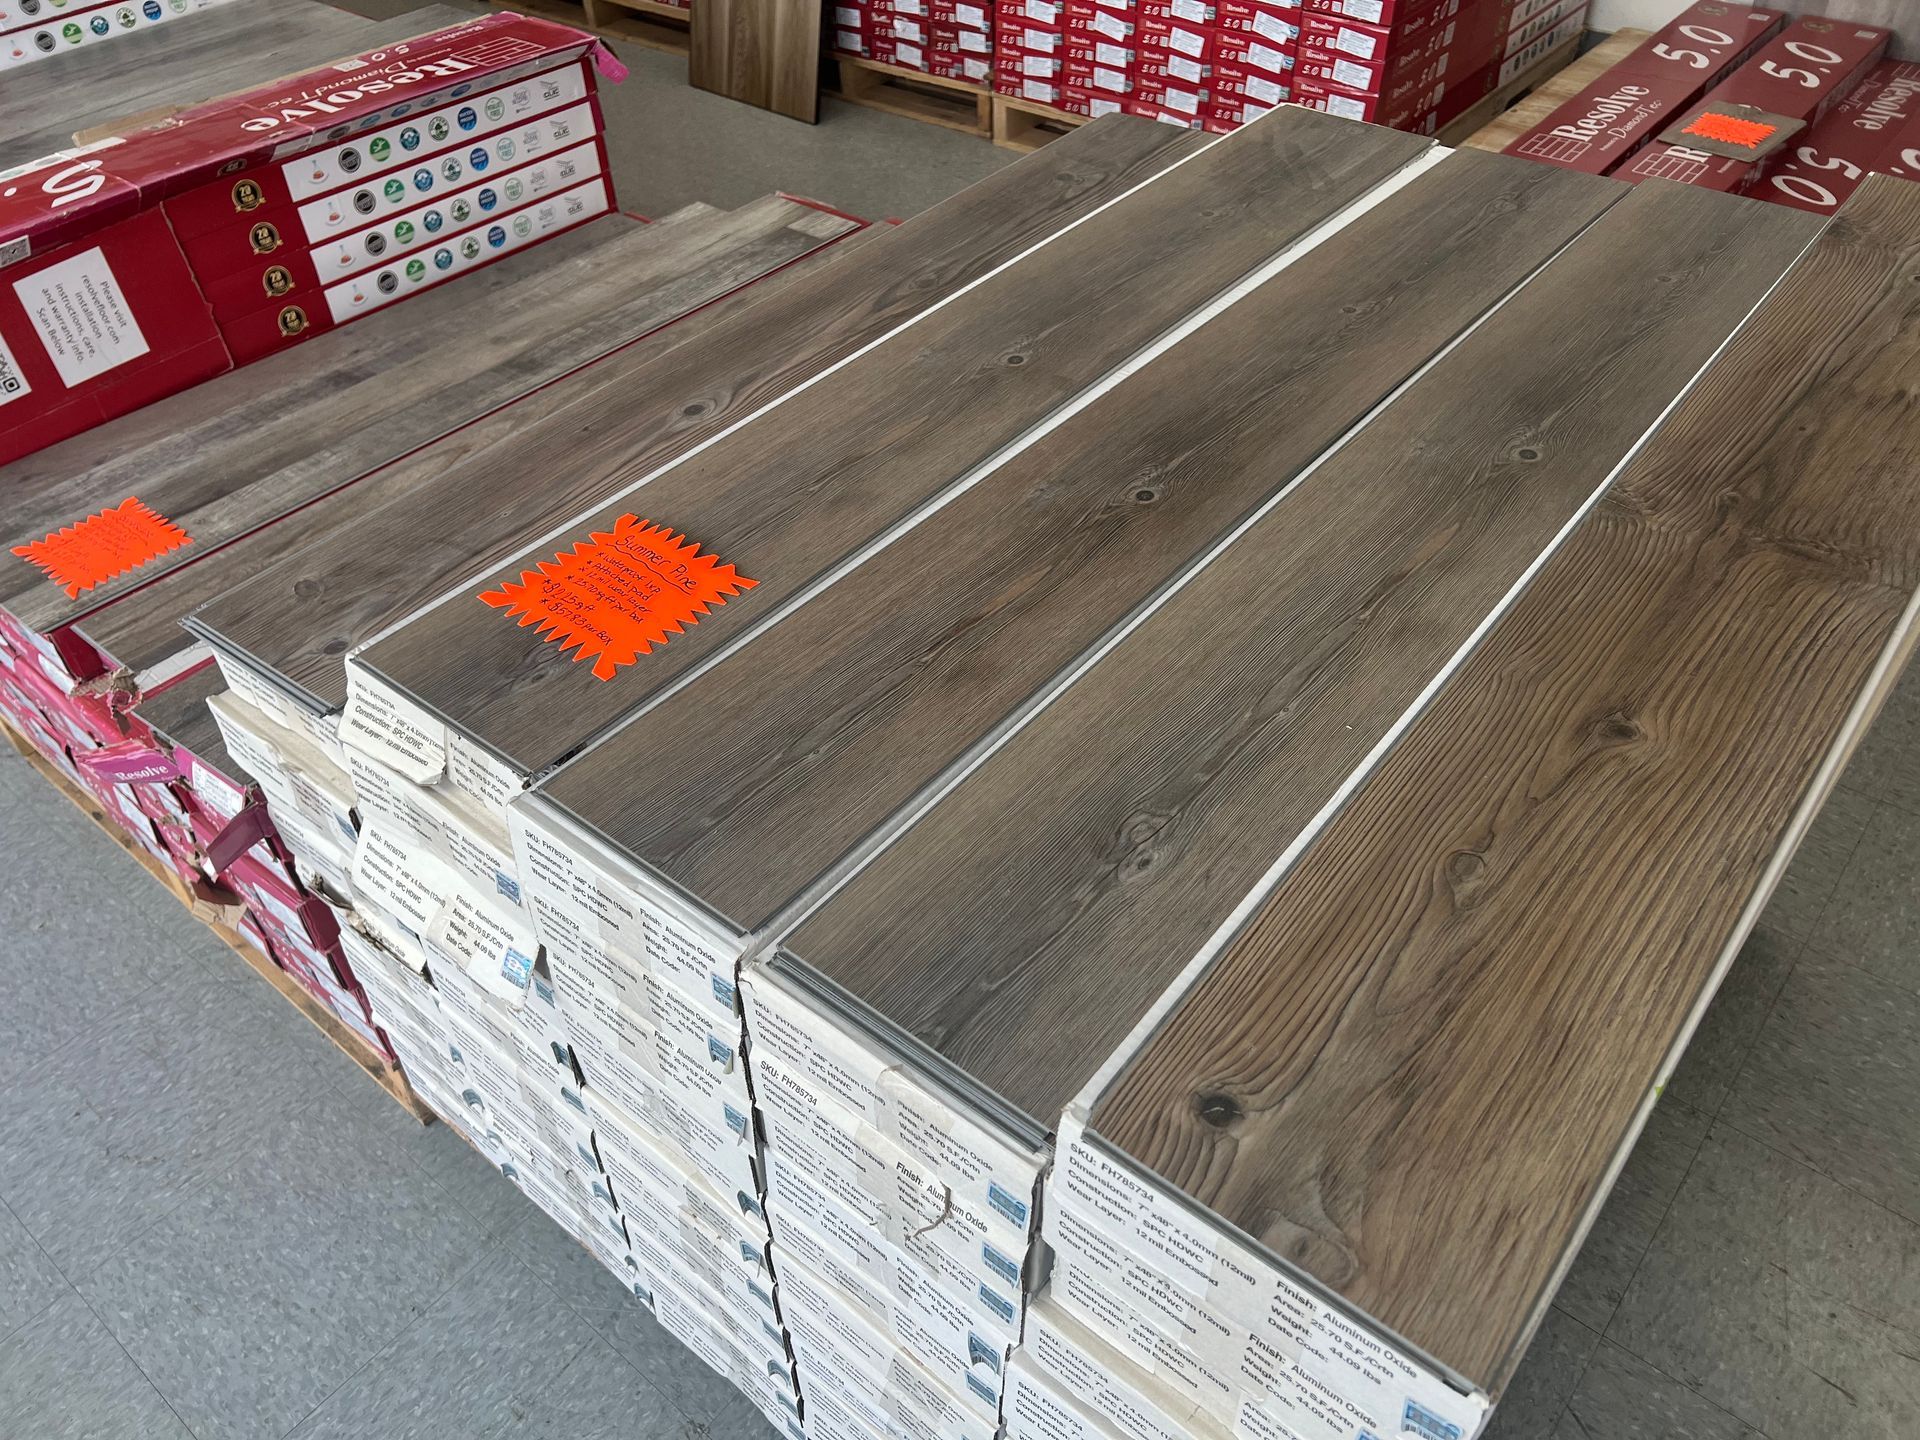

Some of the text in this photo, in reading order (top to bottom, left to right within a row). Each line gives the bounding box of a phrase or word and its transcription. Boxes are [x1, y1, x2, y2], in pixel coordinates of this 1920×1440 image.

[1652, 24, 1734, 69] 5.0
[1760, 41, 1843, 88] 5.0
[241, 58, 478, 131] Resolve
[1549, 85, 1649, 142] Resolve
[1853, 77, 1920, 129] Resolve
[1772, 147, 1862, 205] 5.0
[42, 288, 54, 306] and
[52, 306, 73, 344] warranty
[56, 282, 84, 336] instructions,
[75, 292, 102, 338] installation
[82, 274, 120, 344] resolvefloor.com
[100, 281, 127, 328] Please visit
[37, 307, 65, 356] Scan Below
[592, 563, 629, 587] Attached
[616, 535, 696, 590] Summer Pine
[115, 766, 168, 780] Resolve
[367, 842, 394, 868] Dimensions:
[370, 830, 406, 860] SKU: FH785734
[361, 867, 372, 880] Wear
[373, 877, 386, 892] Layer:
[364, 855, 421, 903] Construction: SPC HDWC
[450, 921, 496, 960] Weight: 44.09 lbs
[453, 908, 466, 922] Area:
[468, 920, 481, 933] 25.70
[456, 895, 514, 941] Finish: Aluminum Oxide
[640, 908, 715, 963] Finish: Aluminum Oxide
[446, 933, 472, 958] Date Code:
[761, 1061, 817, 1106] SKU: FH785734
[897, 1162, 923, 1186] Finish:
[966, 1212, 987, 1232] Oxide
[1071, 1143, 1153, 1202] SKU: FH785734
[1068, 1170, 1203, 1263] Construction: SPC HDWC
[1068, 1181, 1091, 1201] Wear
[1095, 1200, 1125, 1225] Layer:
[1166, 1248, 1218, 1287] Embossed
[1070, 1157, 1131, 1200] Dimensions:
[1183, 1234, 1218, 1260] 4.0mm
[1221, 1259, 1256, 1285] (12mil)
[1059, 1221, 1182, 1312] Construction: SPC HDWC
[1059, 1230, 1081, 1250] Wear
[1084, 1249, 1111, 1272] Layer:
[1148, 1296, 1196, 1334] Embossed
[1061, 1210, 1117, 1254] Dimensions:
[1199, 1310, 1230, 1336] (12mil)
[1269, 1318, 1328, 1362] Date Code:
[1274, 1295, 1304, 1318] Area:
[1311, 1319, 1342, 1342] 25.70
[1277, 1281, 1417, 1378] Finish: Aluminum Oxide
[1246, 1347, 1273, 1369] Area:
[1280, 1371, 1307, 1394] 25.70
[1272, 1306, 1381, 1384] Weight: 44.09 lbs
[1241, 1365, 1295, 1409] Date Code:
[1244, 1355, 1343, 1433] Weight: 44.09 lbs
[1249, 1334, 1376, 1428] Finish: Aluminum Oxide
